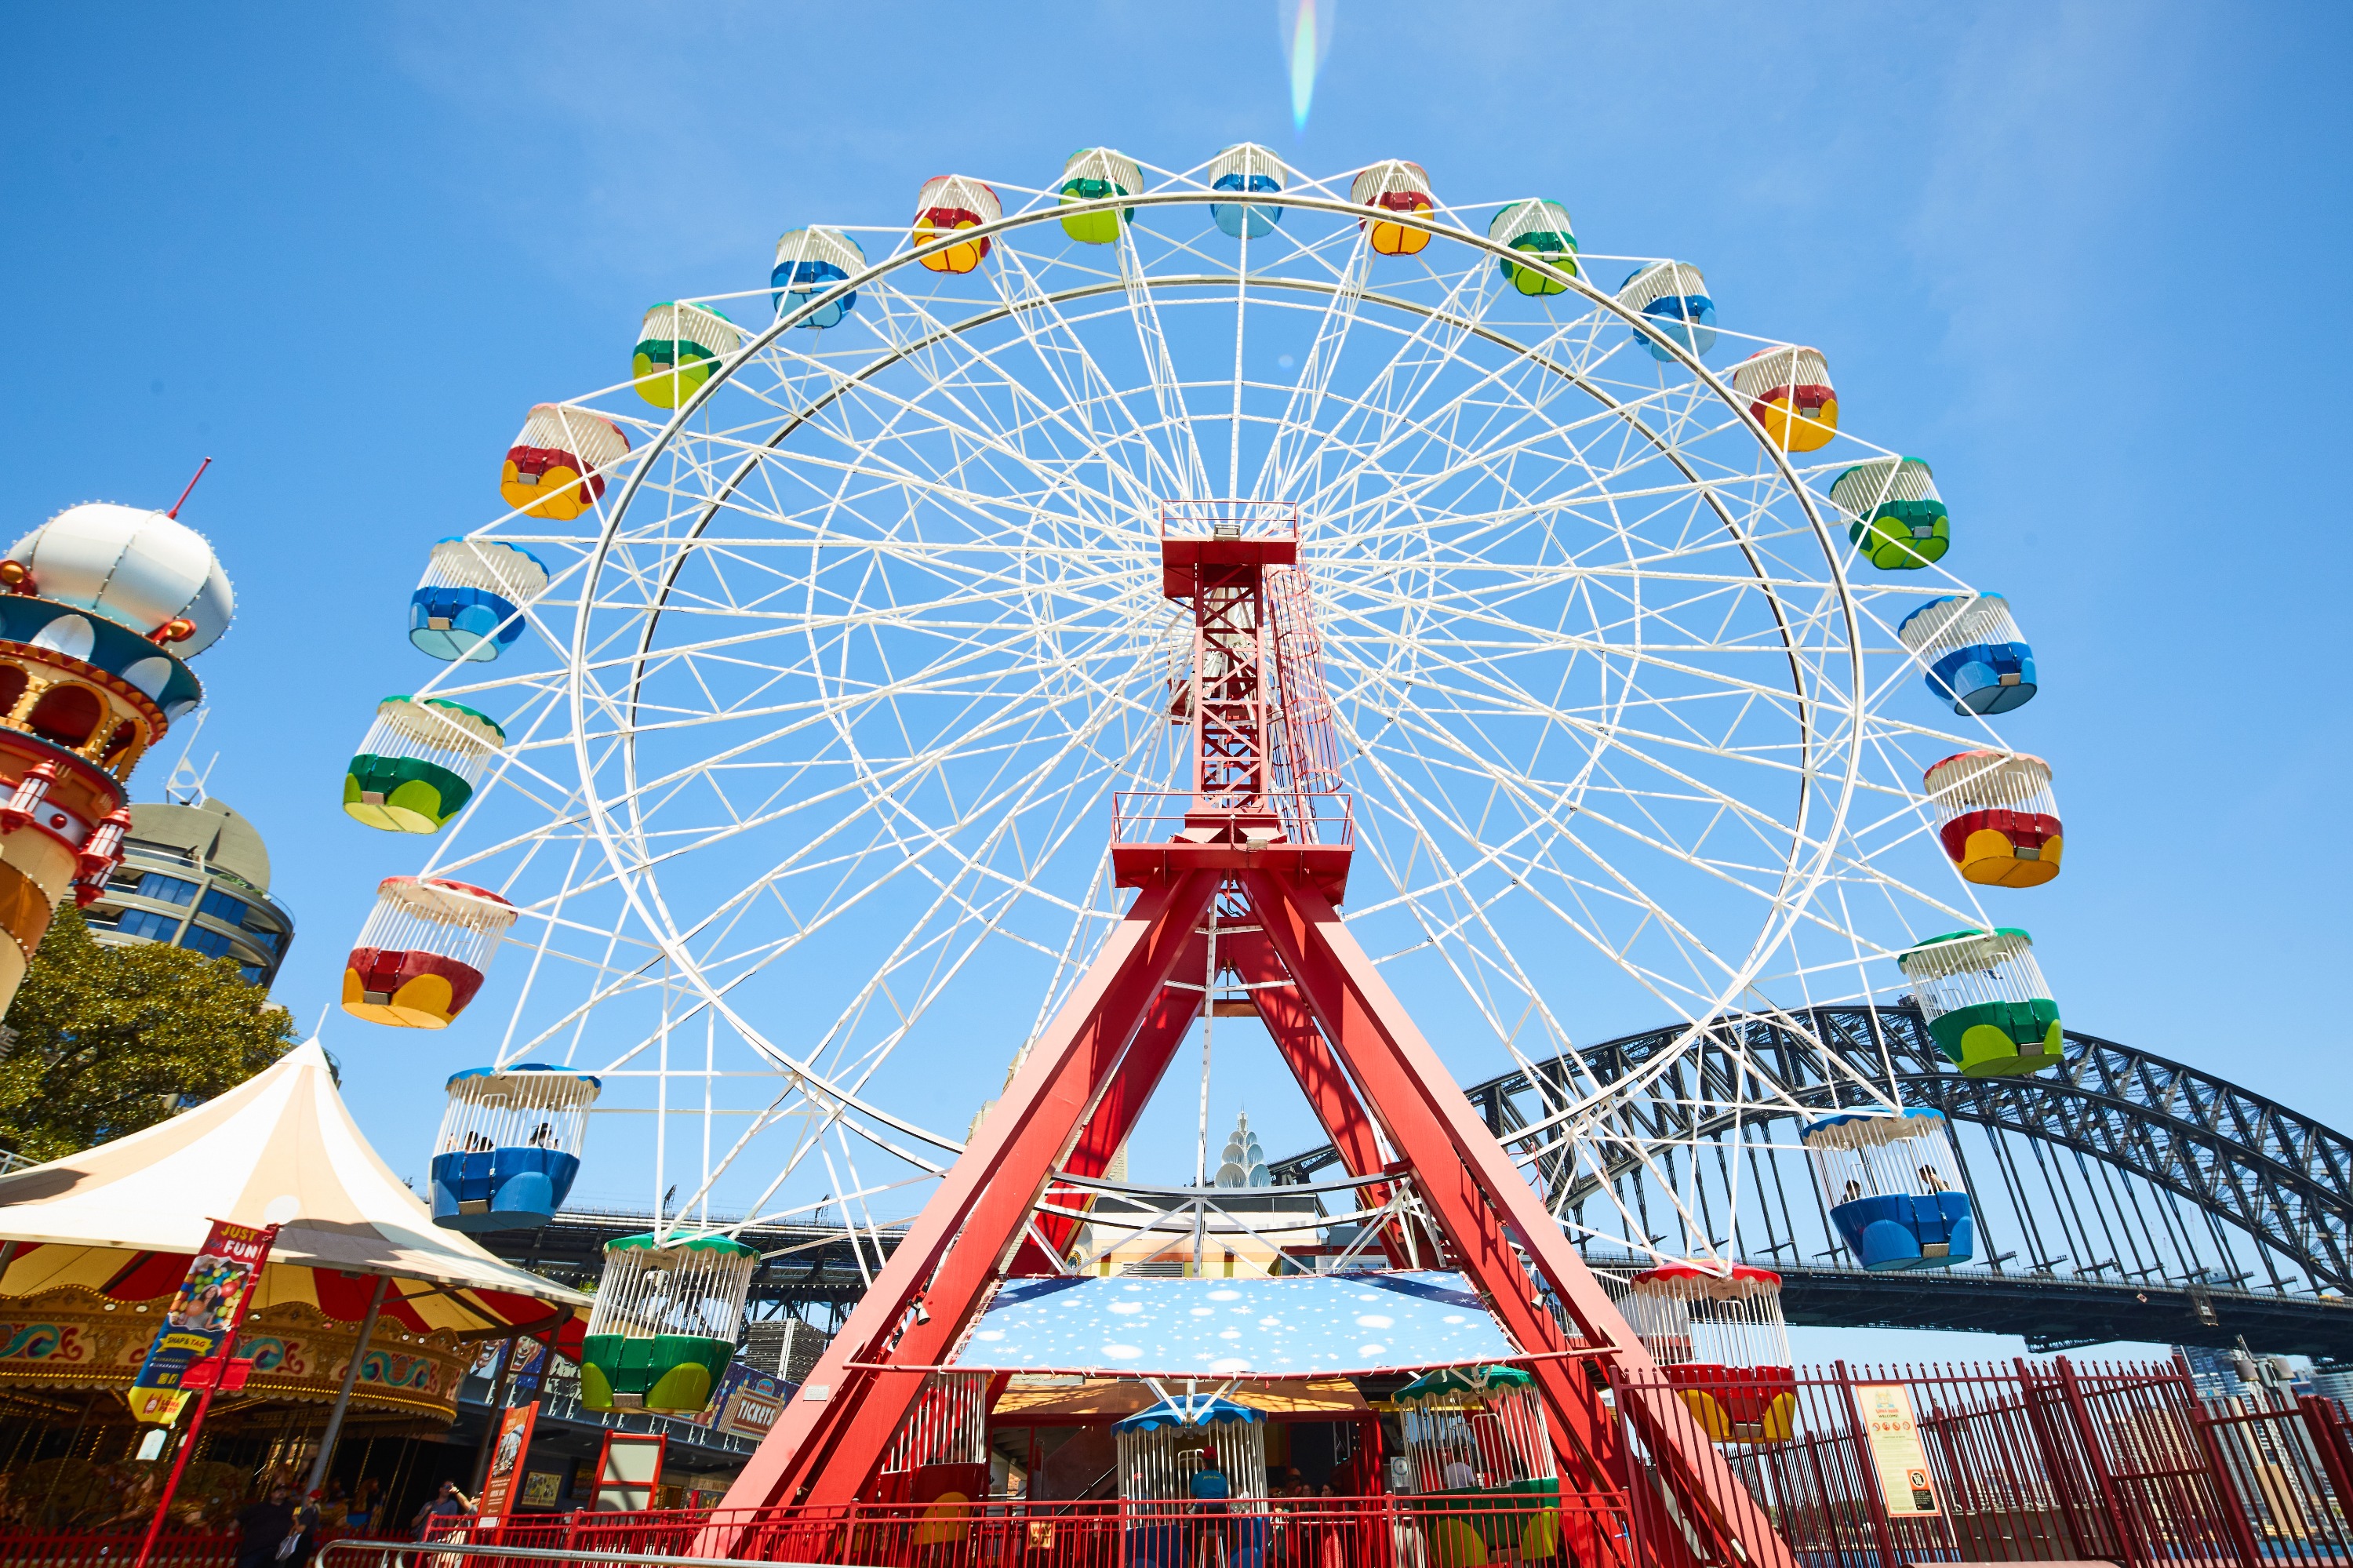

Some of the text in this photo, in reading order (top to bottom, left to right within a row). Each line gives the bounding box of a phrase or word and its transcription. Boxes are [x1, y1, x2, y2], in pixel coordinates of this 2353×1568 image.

[220, 1224, 258, 1242] JUST
[224, 1240, 258, 1259] FUN
[737, 1399, 776, 1427] TICKETS
[1032, 1526, 1052, 1535] WAY
[1031, 1536, 1051, 1544] OUT
